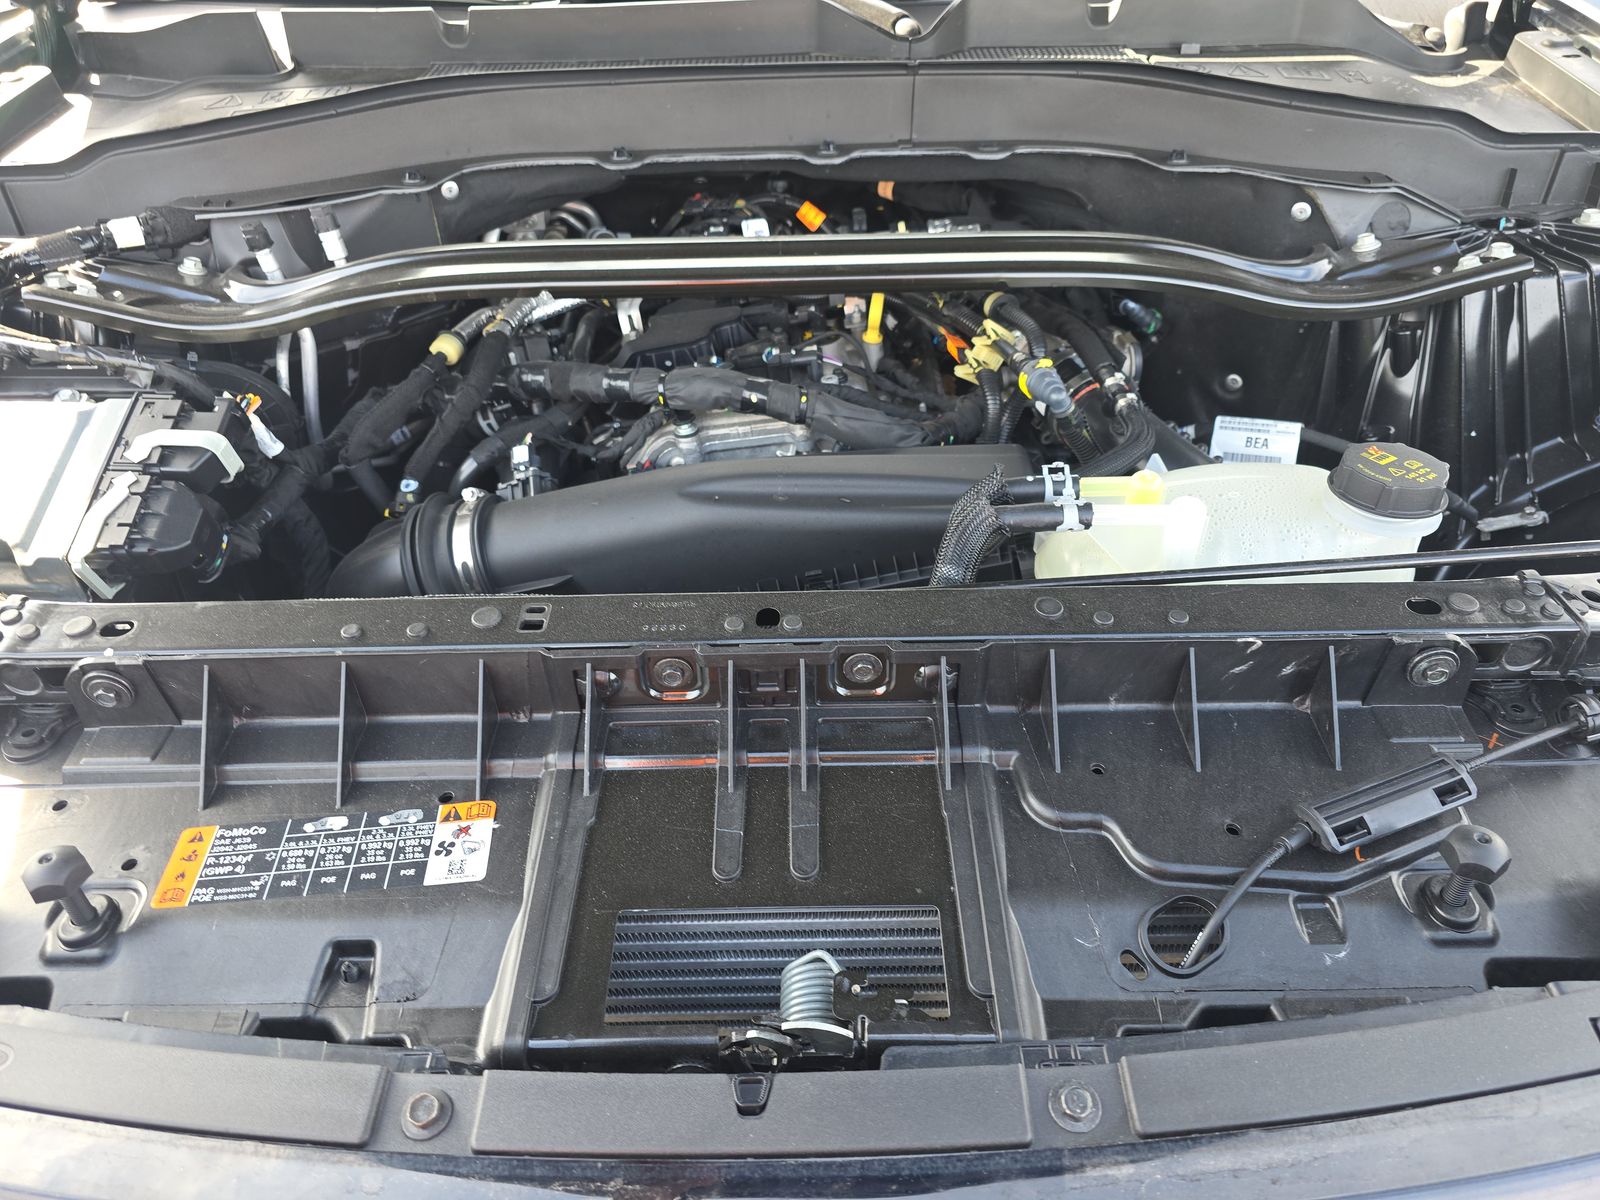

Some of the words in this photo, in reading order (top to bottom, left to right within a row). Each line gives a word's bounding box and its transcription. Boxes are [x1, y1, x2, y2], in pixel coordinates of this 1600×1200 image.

[1245, 436, 1269, 449] BEA
[216, 826, 267, 838] FoMoCo
[214, 838, 232, 846] SAE
[360, 841, 382, 850] 0.992
[382, 841, 394, 850] kg
[398, 838, 420, 847] 0.992
[420, 838, 431, 846] kg
[304, 849, 315, 857] kg
[319, 846, 342, 855] 0.737
[342, 845, 353, 854] kg
[206, 854, 254, 865] R-1234yf
[202, 865, 233, 877] (GWP
[234, 864, 246, 874] 4)
[399, 868, 416, 876] POE
[320, 876, 337, 884] POE
[360, 872, 377, 880] PAG
[280, 879, 297, 887] PAG
[193, 887, 216, 896] PAG
[191, 894, 214, 902] POE
